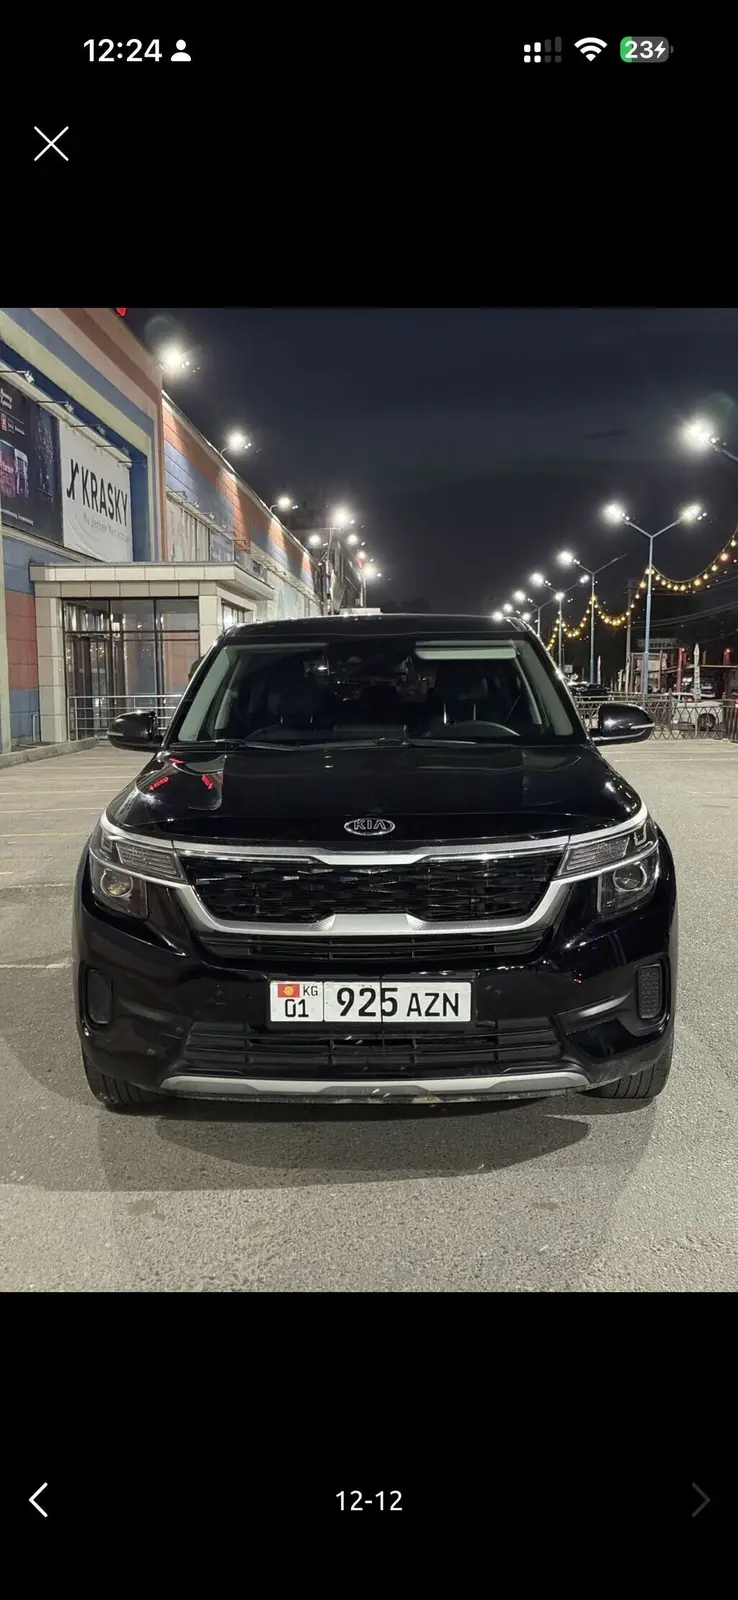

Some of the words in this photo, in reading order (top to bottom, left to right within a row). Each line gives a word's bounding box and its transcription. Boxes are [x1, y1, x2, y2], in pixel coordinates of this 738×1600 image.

[81, 465, 128, 527] KRASKY
[353, 820, 387, 830] KIA
[303, 986, 318, 997] KG
[285, 999, 309, 1018] 01
[336, 987, 398, 1017] 925
[406, 993, 459, 1017] AZN
